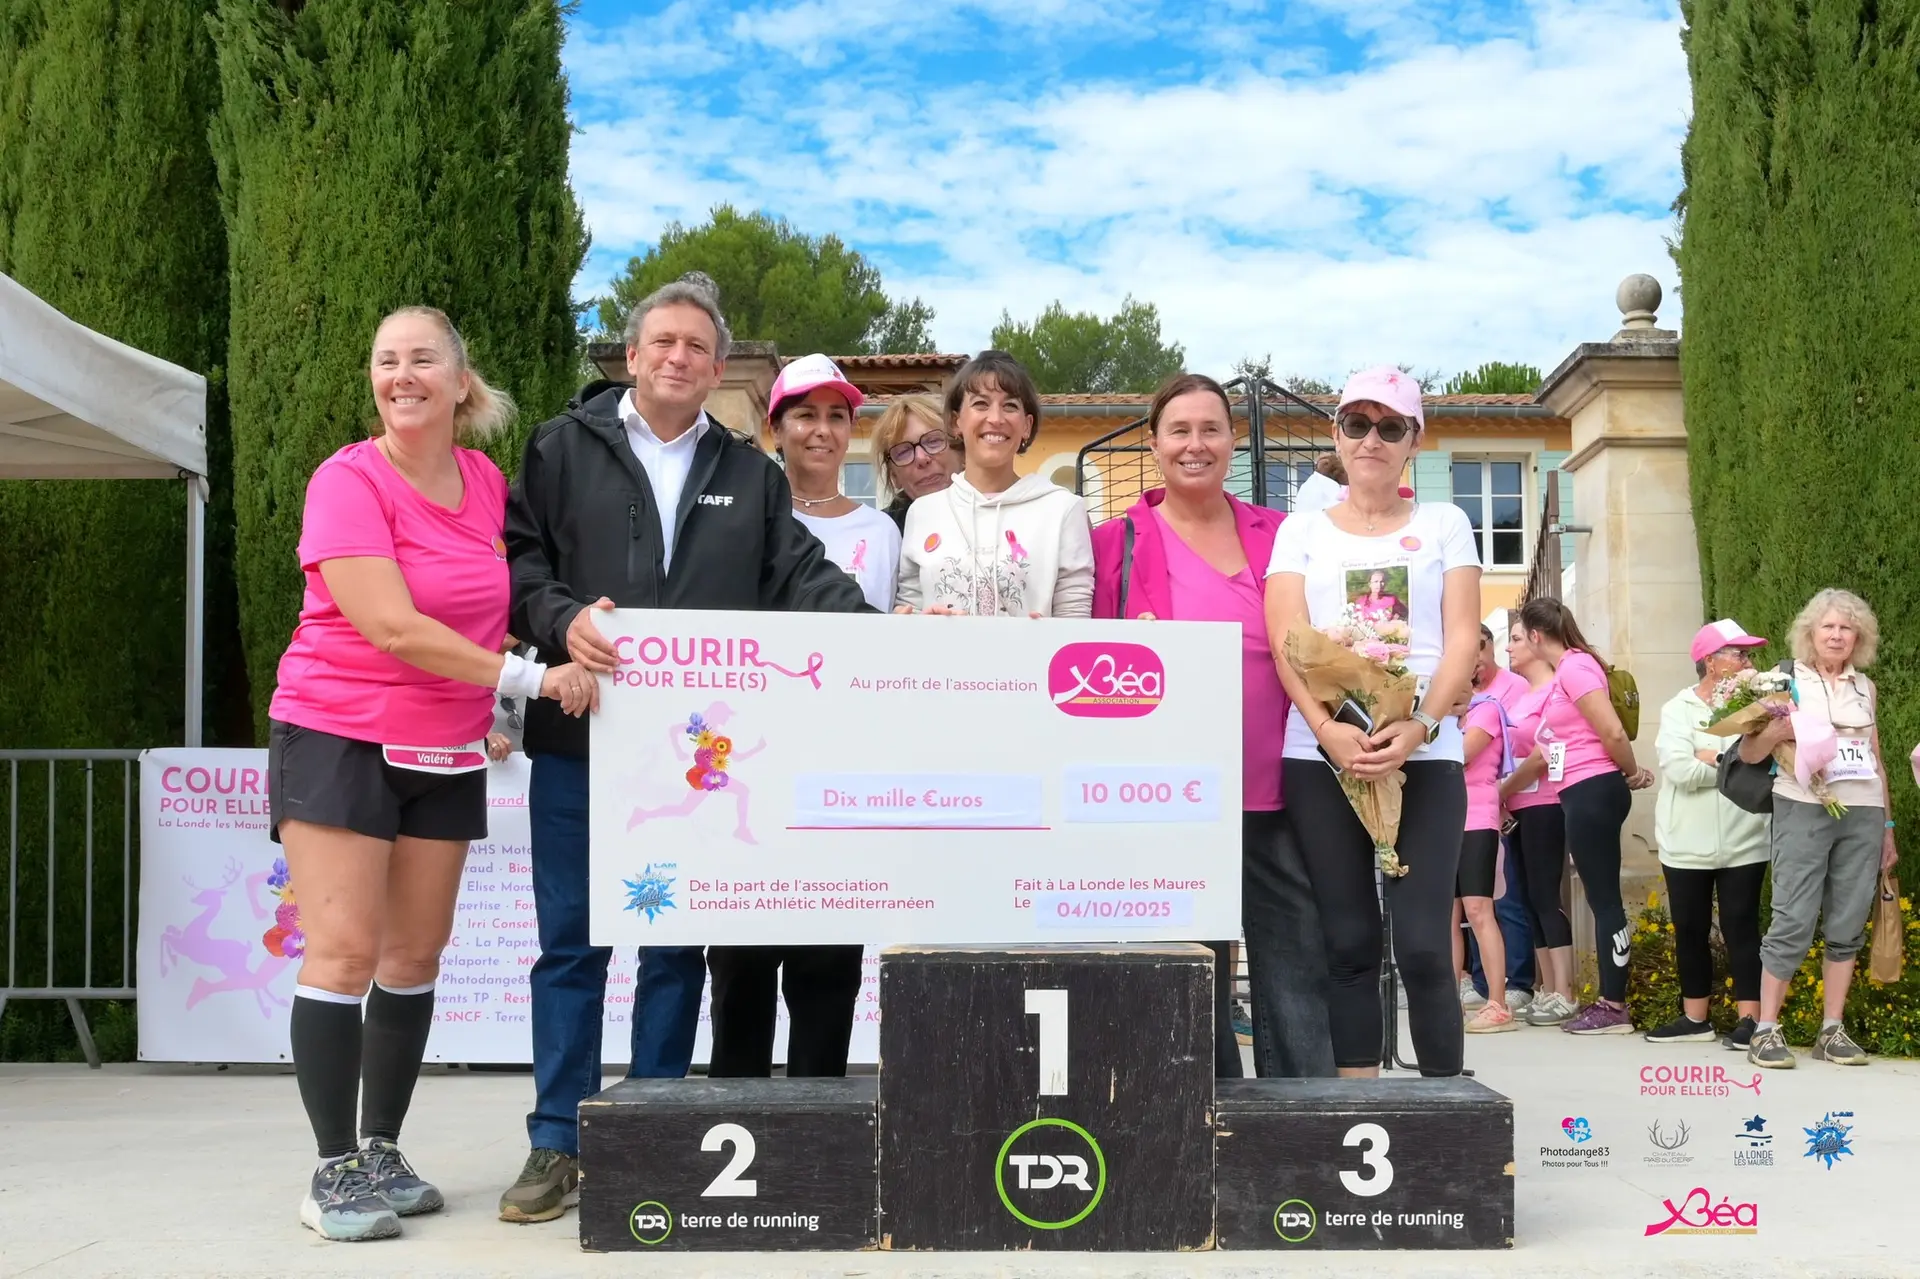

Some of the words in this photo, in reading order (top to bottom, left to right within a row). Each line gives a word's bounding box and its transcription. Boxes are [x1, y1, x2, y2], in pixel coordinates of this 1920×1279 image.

[612, 636, 763, 667] COURIR
[612, 670, 674, 687] POUR
[683, 671, 767, 692] ELLE(S)
[850, 677, 871, 690] Au
[876, 677, 918, 692] profit
[922, 677, 941, 690] de
[946, 678, 1038, 692] l'association
[417, 752, 454, 765] Valérie
[1839, 748, 1863, 761] 174
[823, 789, 858, 807] Dix
[866, 788, 917, 808] mille
[922, 789, 983, 808] €uros
[1081, 782, 1109, 804] 10
[1118, 782, 1172, 804] 000
[1182, 780, 1202, 804] €
[160, 797, 217, 814] POUR
[158, 818, 172, 827] La
[176, 818, 211, 829] Londe
[216, 818, 230, 829] les
[235, 821, 271, 830] Maure
[468, 844, 496, 855] AHS
[467, 881, 496, 892] Elise
[689, 880, 710, 892] De
[715, 880, 729, 892] la
[733, 880, 765, 895] part
[770, 879, 789, 892] de
[794, 879, 888, 892] l'association
[1014, 878, 1042, 891] Fait
[1046, 878, 1054, 891] à
[1059, 879, 1075, 891] La
[1080, 878, 1125, 891] Londe
[1129, 878, 1149, 890] les
[1153, 878, 1206, 890] Maures
[689, 897, 750, 910] Londais
[754, 896, 816, 910] Athlétic
[821, 896, 934, 910] Méditerranéen
[1014, 896, 1031, 908] Le
[1057, 900, 1171, 918] 04/10/2025
[468, 918, 486, 929] Irri
[475, 937, 491, 947] La
[440, 955, 500, 967] Delaporte
[473, 993, 489, 1003] TP
[445, 1012, 482, 1022] SNCF
[495, 1012, 526, 1022] Terre
[1024, 989, 1069, 1095] 1
[700, 1123, 757, 1197] 2
[1338, 1123, 1394, 1197] 3
[1009, 1154, 1093, 1191] TDR
[681, 1213, 722, 1228] terre
[727, 1212, 748, 1228] de
[753, 1212, 819, 1231] running
[1325, 1211, 1366, 1227] terre
[1371, 1210, 1393, 1227] de
[1398, 1210, 1464, 1229] running
